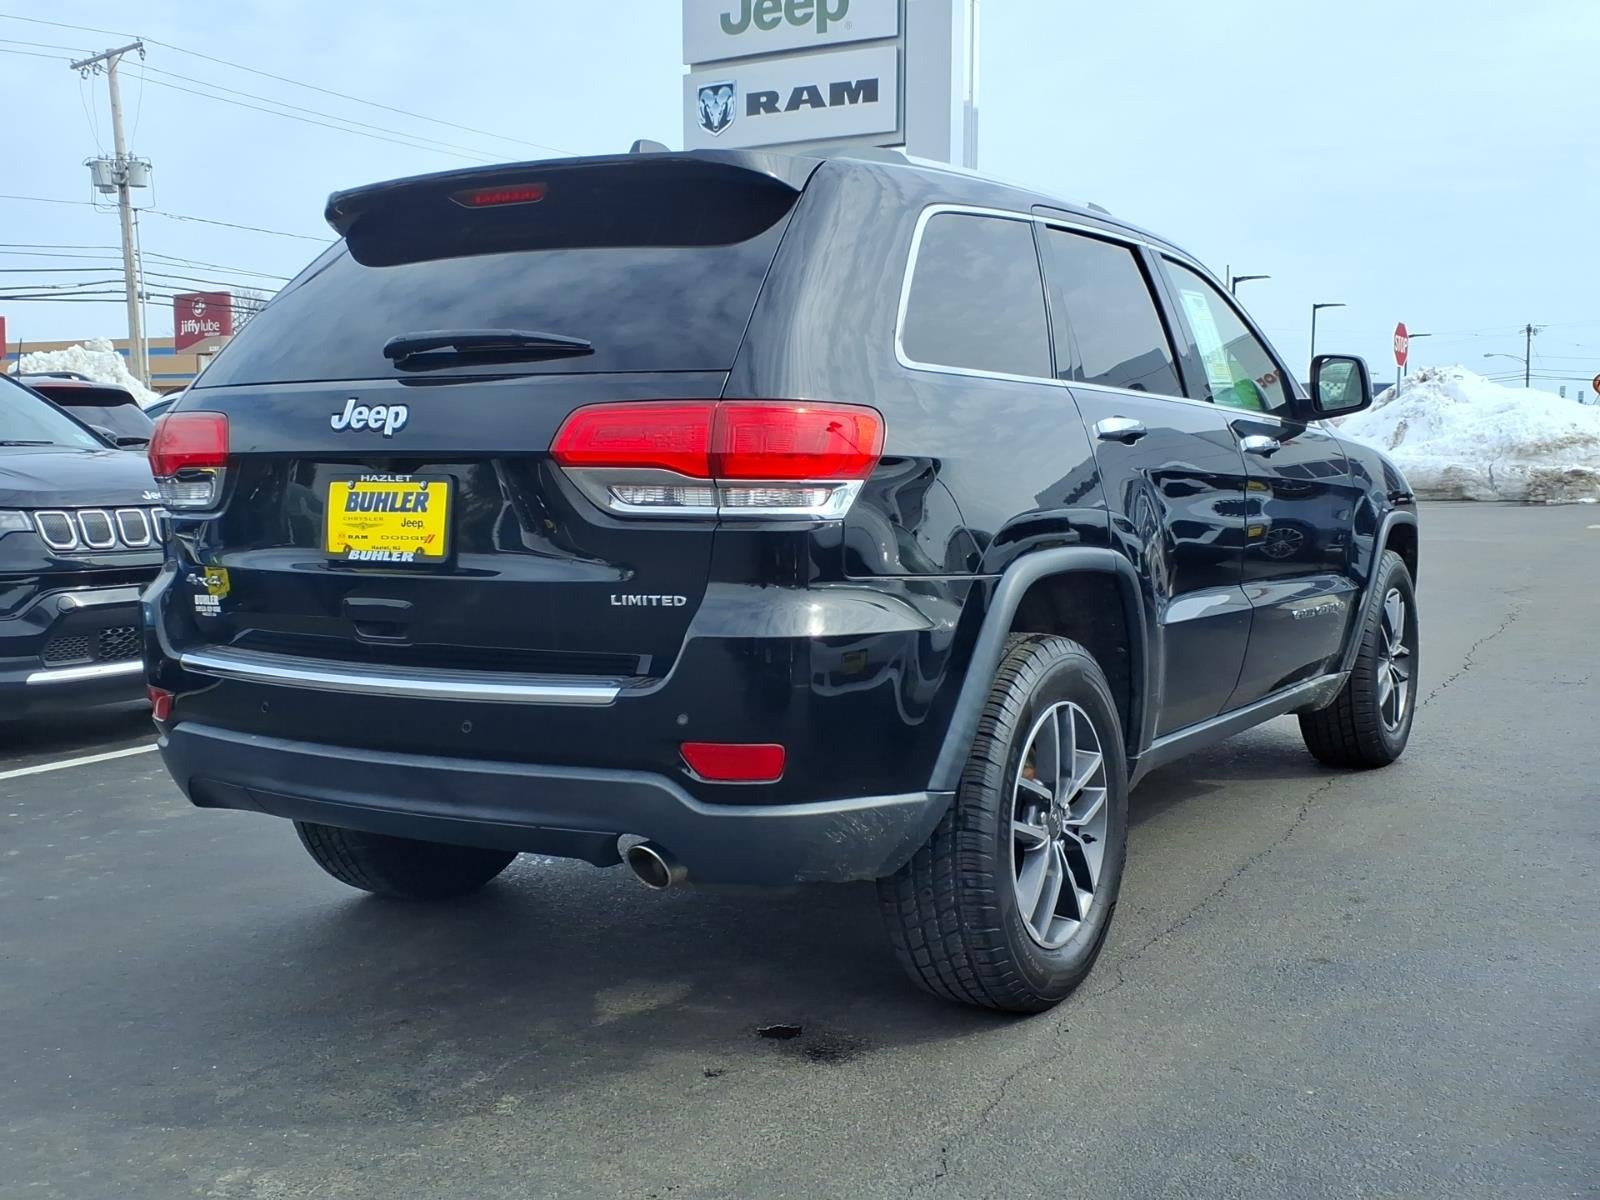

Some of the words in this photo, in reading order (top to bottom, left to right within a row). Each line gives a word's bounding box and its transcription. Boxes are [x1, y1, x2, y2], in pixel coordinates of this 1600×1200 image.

[720, 0, 849, 35] Jeep
[746, 78, 879, 117] RAM
[1395, 335, 1408, 353] STOP
[330, 399, 408, 436] Jeep
[344, 491, 430, 513] BUHLER
[401, 518, 424, 529] Jeep
[348, 550, 414, 562] BUHLER
[610, 594, 687, 607] LIMITED
